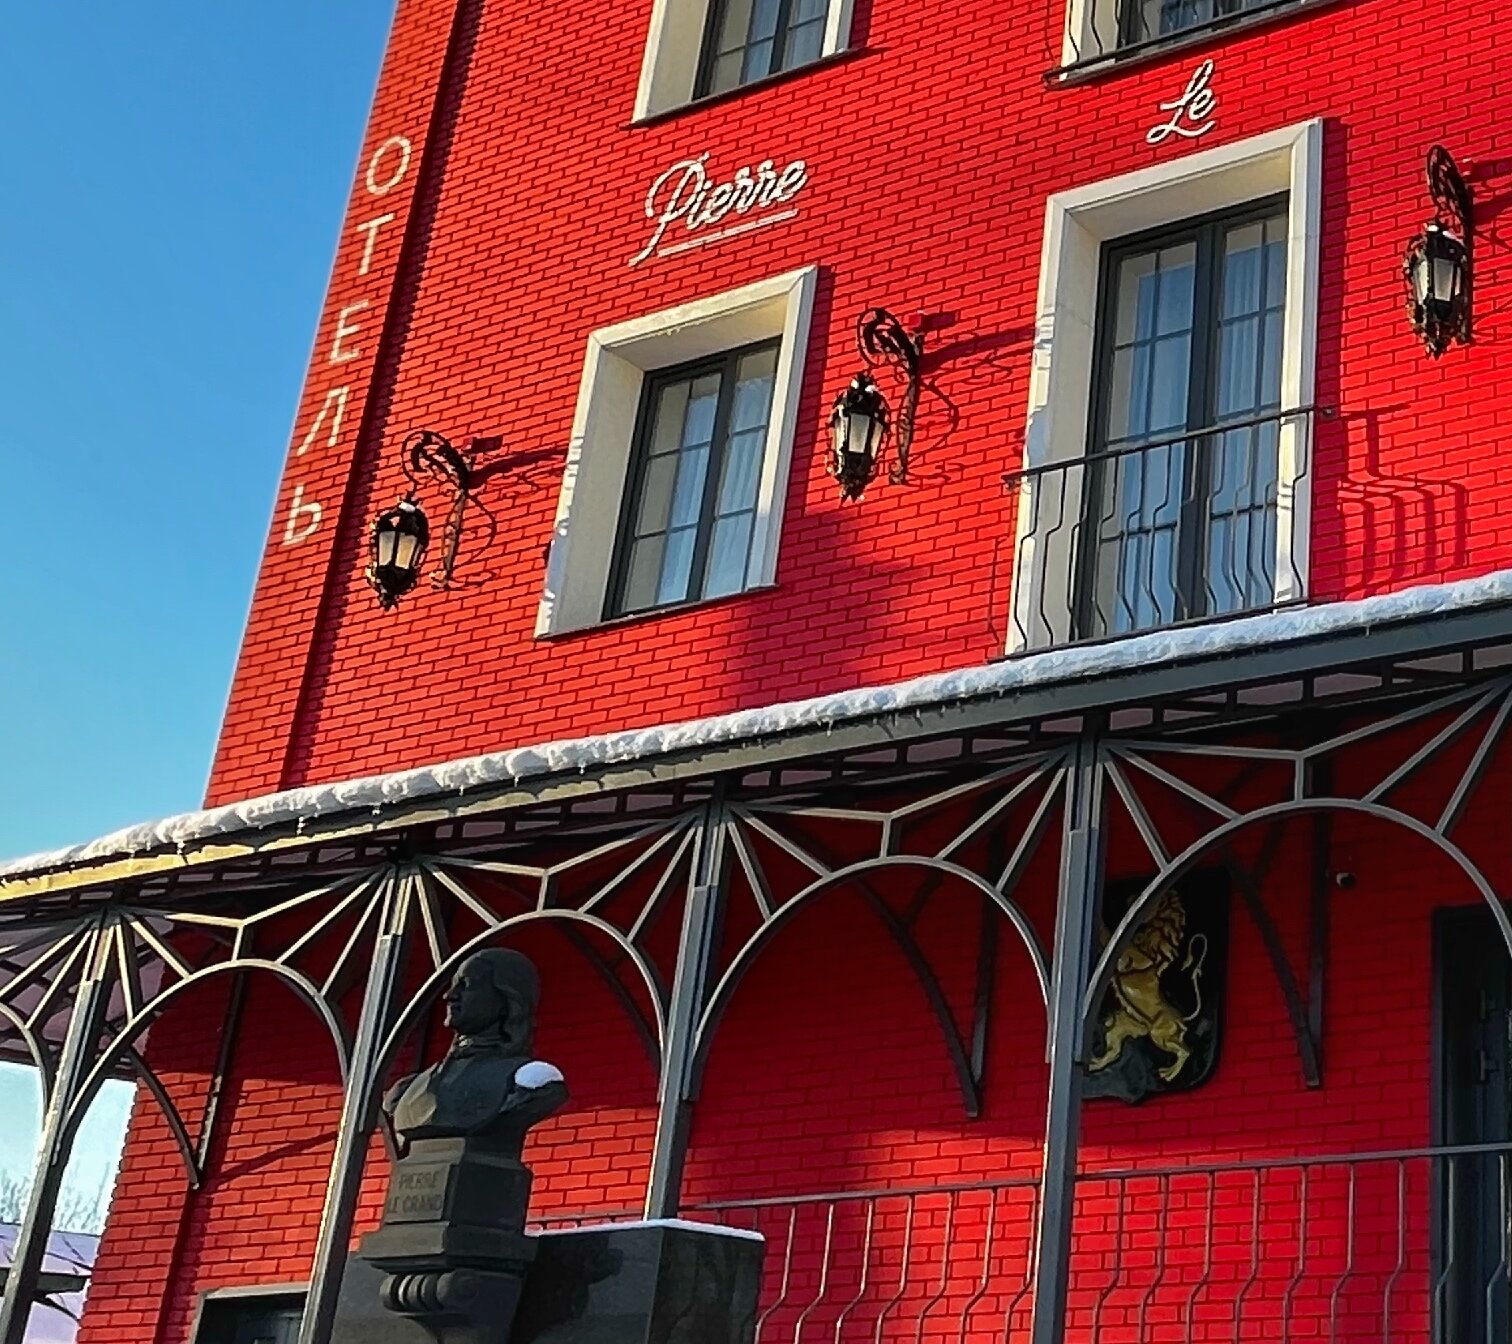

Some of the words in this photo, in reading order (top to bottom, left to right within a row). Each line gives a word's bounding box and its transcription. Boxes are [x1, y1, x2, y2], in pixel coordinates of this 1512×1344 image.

[628, 151, 808, 268] Pierre
[1146, 59, 1217, 143] Le
[282, 135, 411, 546] ОТЕЛЬ
